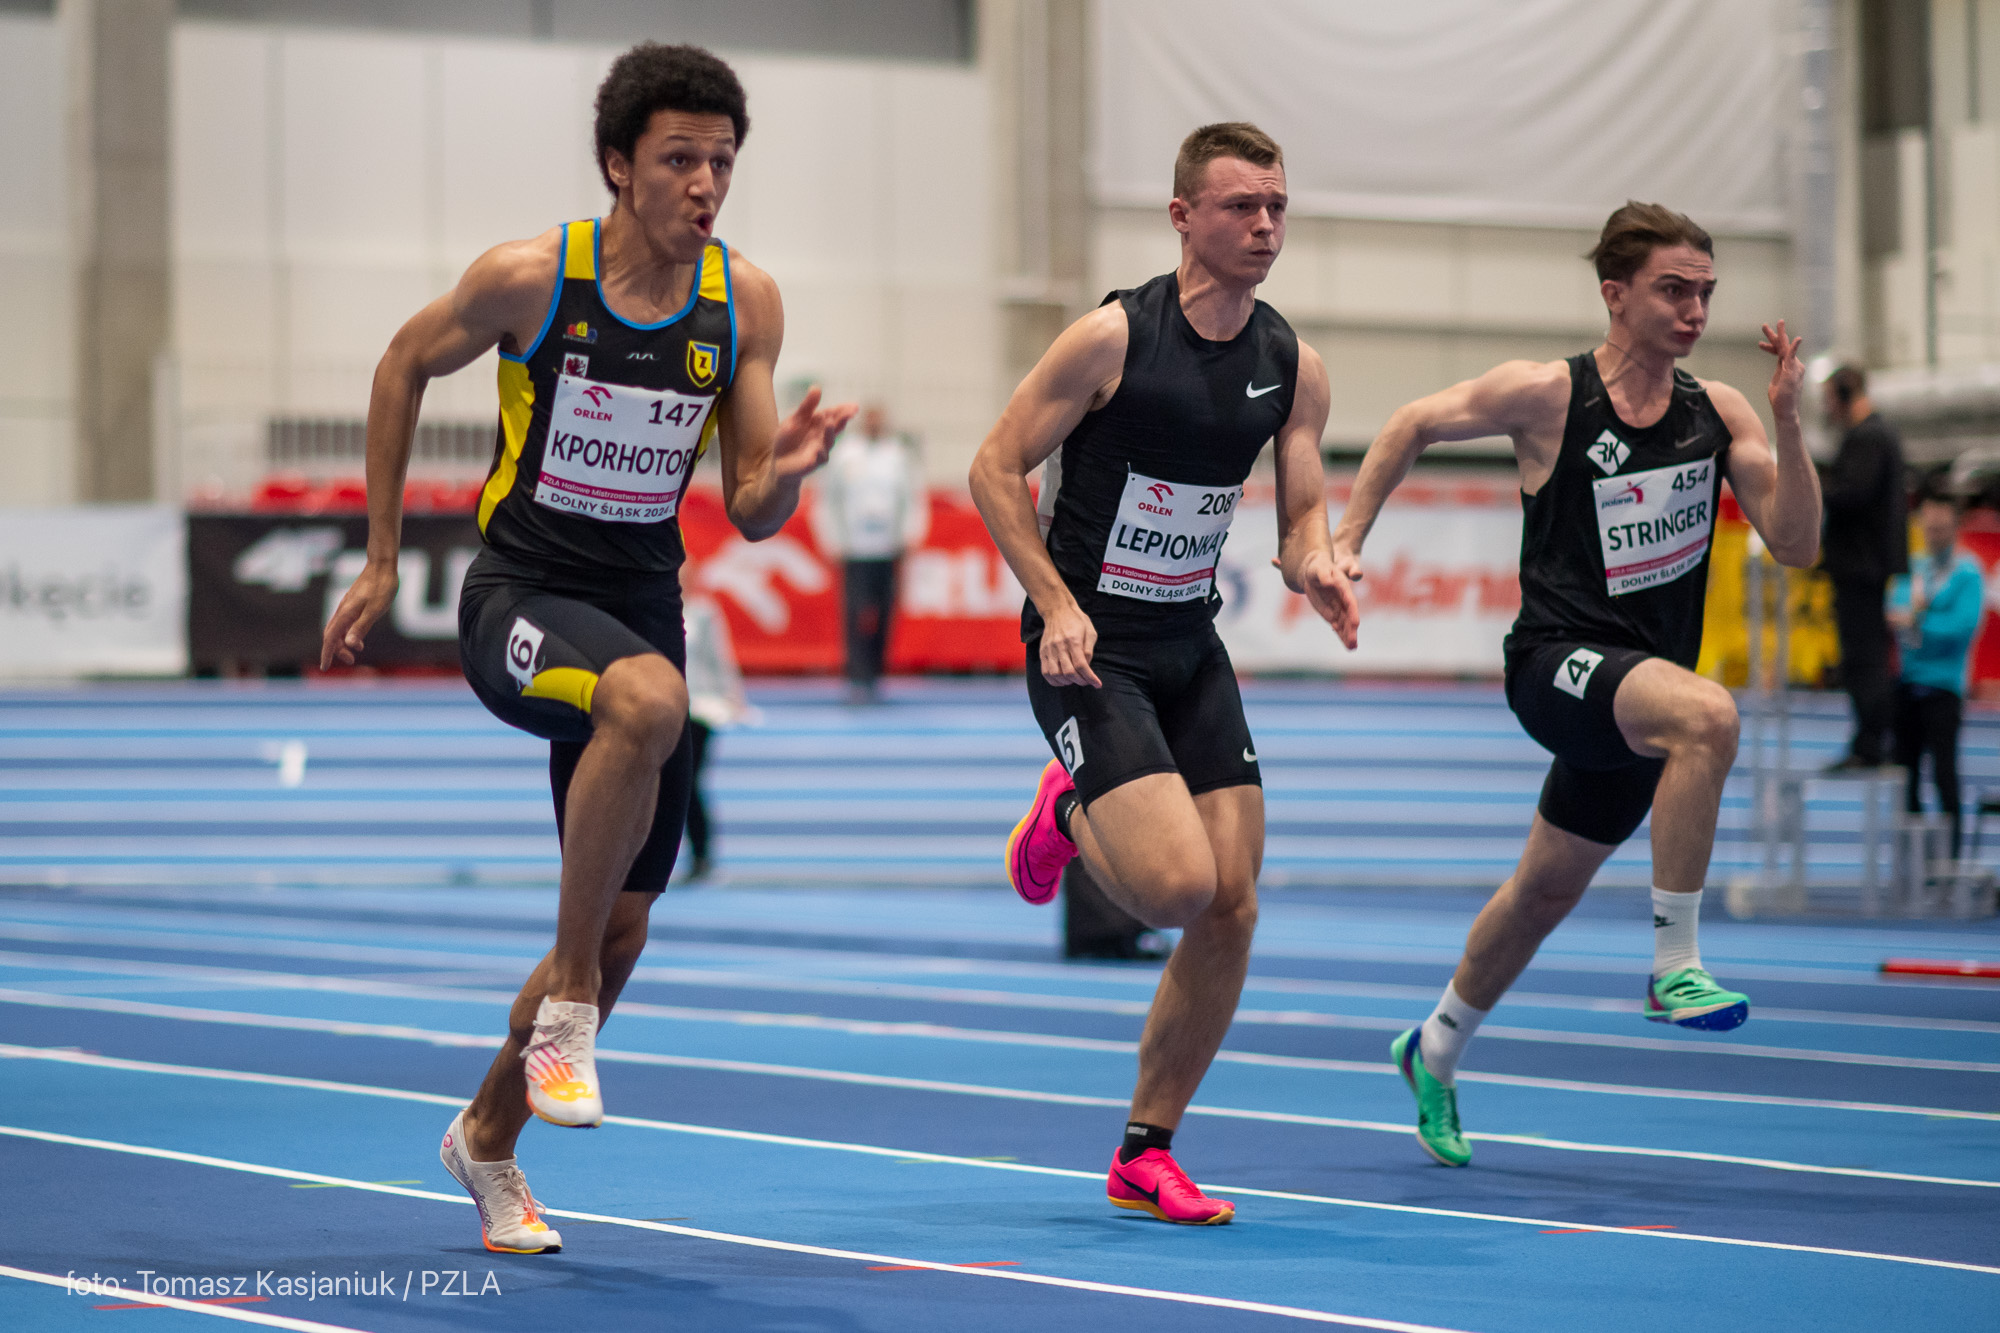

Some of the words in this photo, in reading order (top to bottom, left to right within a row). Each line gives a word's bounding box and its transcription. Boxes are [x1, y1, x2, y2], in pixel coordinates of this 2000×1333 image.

[573, 407, 613, 422] ORLEN
[648, 400, 703, 428] 147
[543, 475, 560, 487] PZLA
[561, 483, 590, 495] Halowe
[592, 488, 637, 502] Mistrzostwa
[1671, 465, 1709, 493] 454
[551, 493, 598, 512] DOLNY
[600, 502, 641, 519] ŚLĄSK
[643, 506, 670, 518] 2024
[1138, 502, 1173, 517] ORLEN
[1197, 492, 1235, 516] 208
[1601, 495, 1634, 510] polanik
[1607, 501, 1708, 551] STRINGER
[1115, 524, 1221, 560] LEPIONKA
[1105, 565, 1121, 574] PZLA
[1122, 568, 1148, 579] Halowe
[1621, 572, 1658, 589] DOLNY
[1112, 580, 1154, 596] DOLNY
[1154, 587, 1184, 600] ŚLĄSK
[1185, 584, 1201, 596] 2024
[510, 634, 533, 671] 6
[1567, 658, 1591, 687] 4
[1061, 725, 1076, 771] 5
